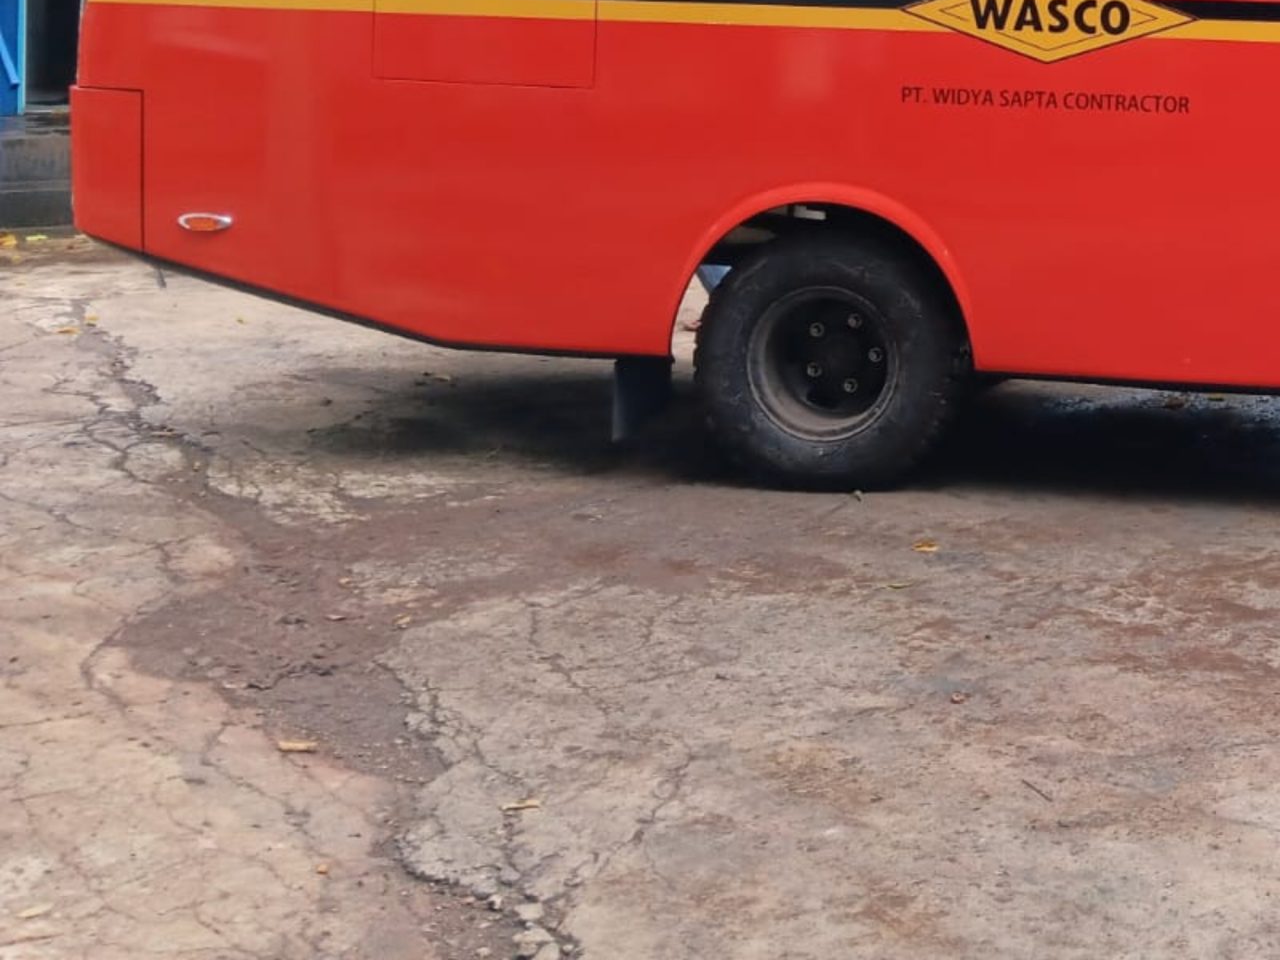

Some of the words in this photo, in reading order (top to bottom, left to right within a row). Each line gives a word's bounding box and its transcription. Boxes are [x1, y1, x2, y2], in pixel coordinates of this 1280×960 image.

[901, 86, 927, 103] PT.
[932, 87, 994, 107] WIDYA
[1000, 89, 1058, 109] SAPTA
[1063, 92, 1190, 114] CONTRACTOR
